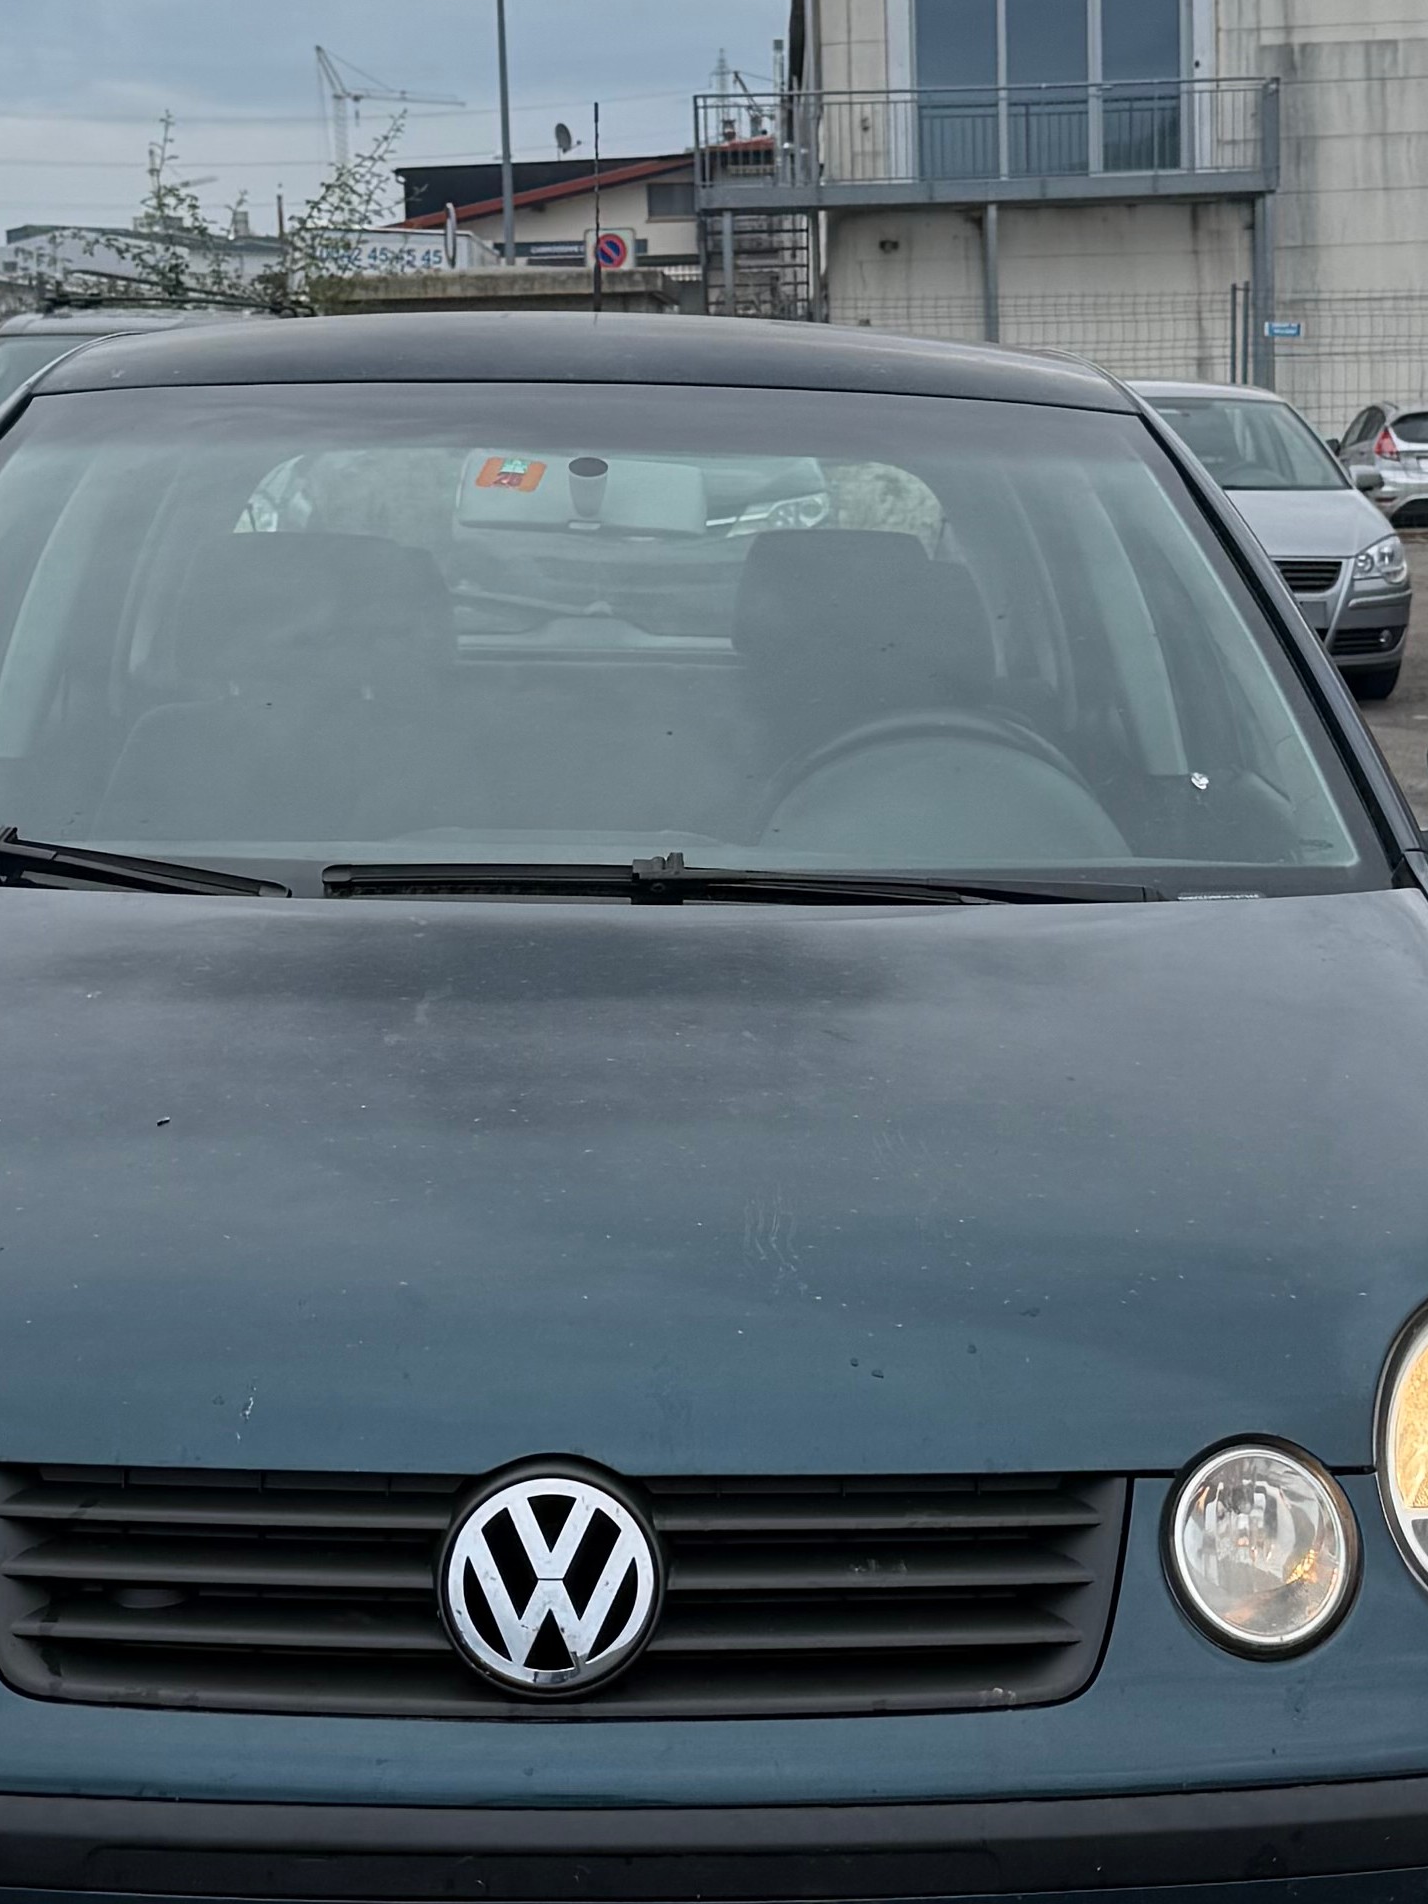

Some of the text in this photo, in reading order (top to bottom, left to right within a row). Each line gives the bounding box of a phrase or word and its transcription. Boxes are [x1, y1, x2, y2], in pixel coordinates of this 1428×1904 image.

[368, 247, 389, 262] 45
[421, 249, 443, 265] 45
[448, 1478, 654, 1684] VW
